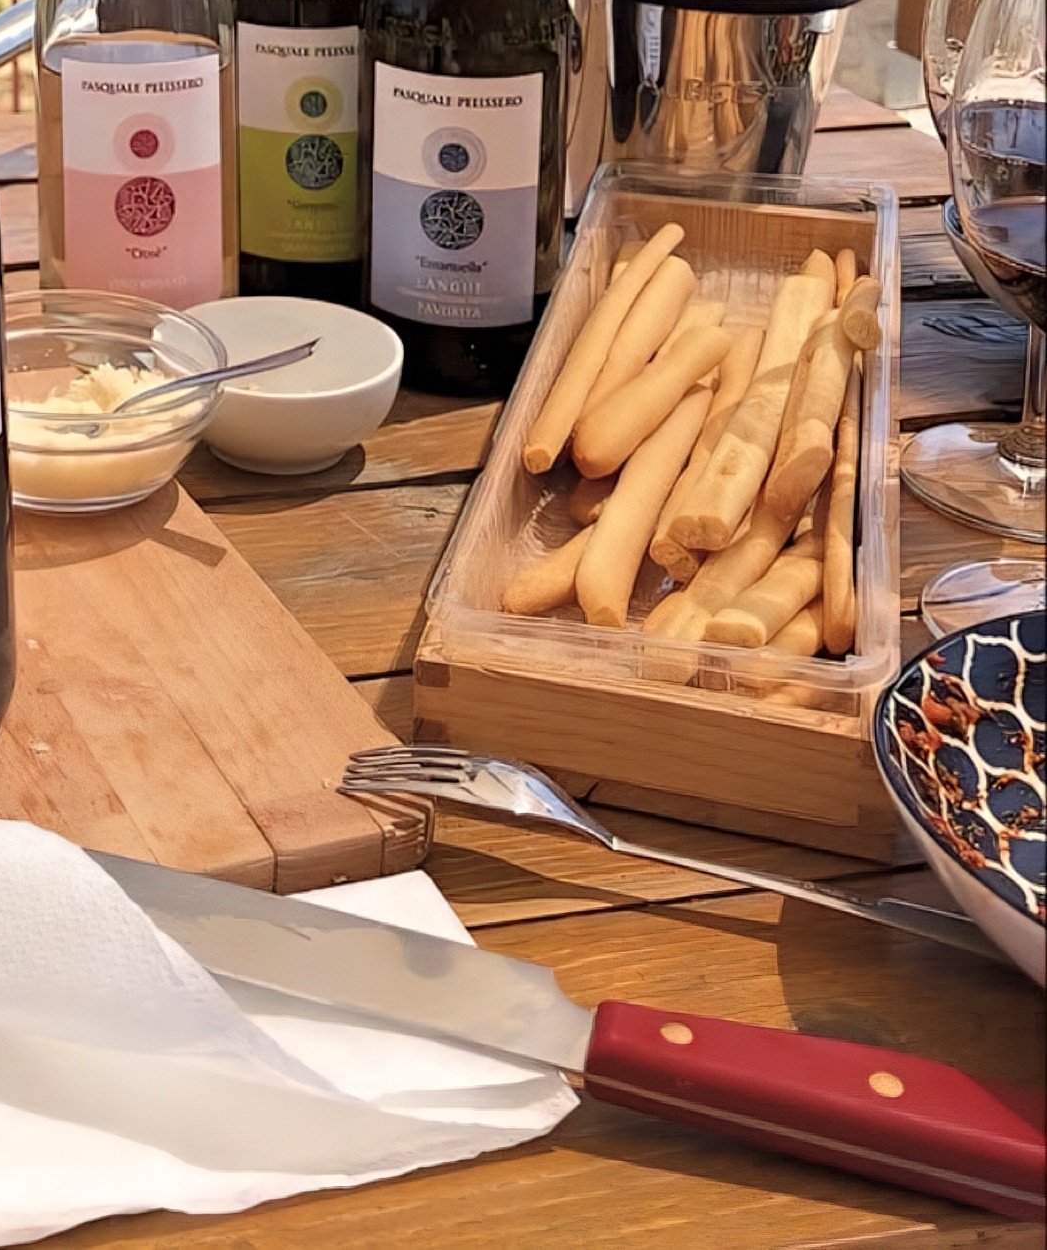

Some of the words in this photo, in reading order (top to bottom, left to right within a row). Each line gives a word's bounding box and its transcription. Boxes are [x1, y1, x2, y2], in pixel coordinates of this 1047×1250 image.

[314, 46, 356, 57] PELISSE
[393, 87, 451, 106] PASQUALE
[457, 96, 523, 108] PELISSERO
